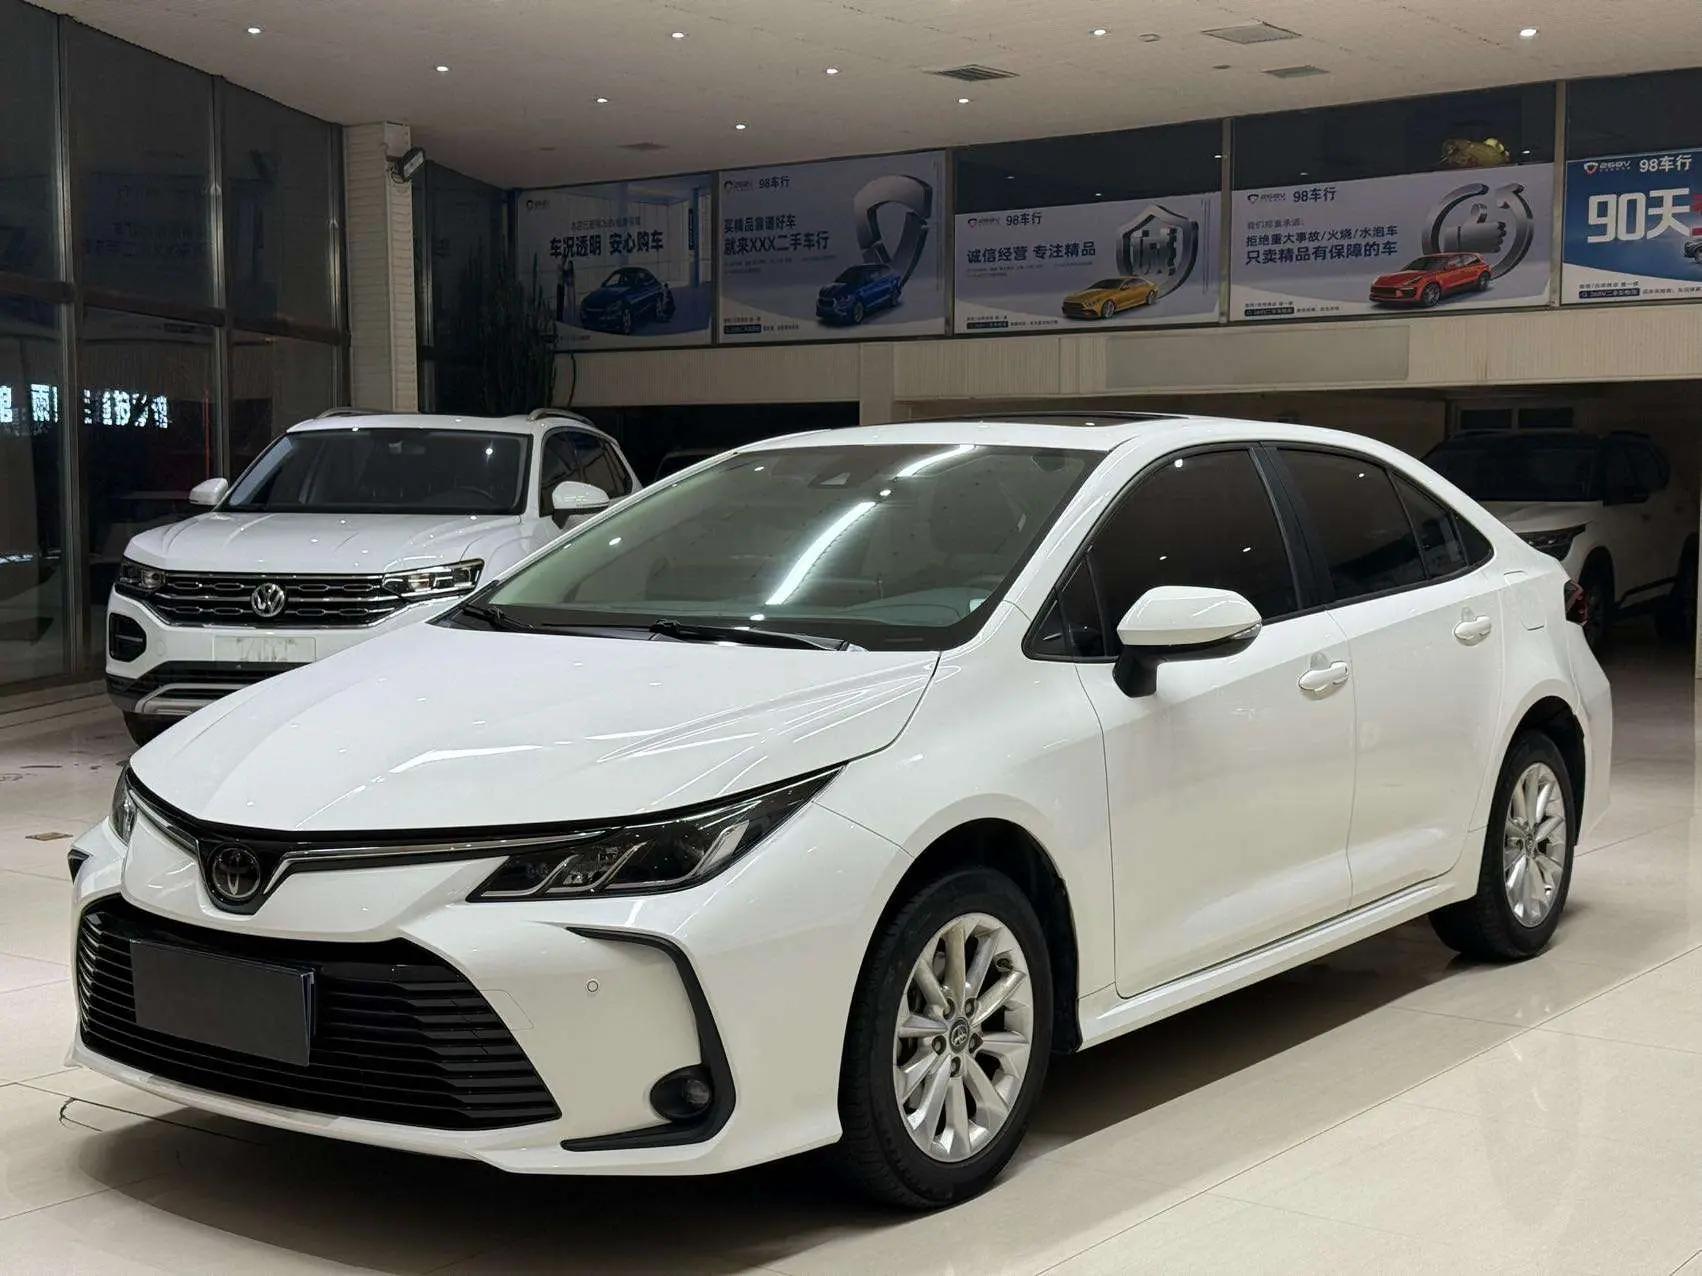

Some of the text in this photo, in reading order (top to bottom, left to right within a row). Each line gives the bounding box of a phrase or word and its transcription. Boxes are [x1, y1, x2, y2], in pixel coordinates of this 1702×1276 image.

[1639, 154, 1692, 173] 98车行
[758, 175, 792, 190] 98车行
[1292, 186, 1337, 203] 98车行
[1006, 211, 1042, 227] 98车行
[1587, 187, 1691, 244] 90天
[549, 233, 602, 259] 车况透明
[609, 229, 664, 256] 安心购车
[723, 230, 830, 256] 就来XXX二手车行
[1246, 224, 1398, 248] 拒绝重大事故/火烧/水泡车
[967, 241, 1096, 263] 诚信经营 专注精品
[1246, 240, 1398, 266] 只卖精品有保障的车
